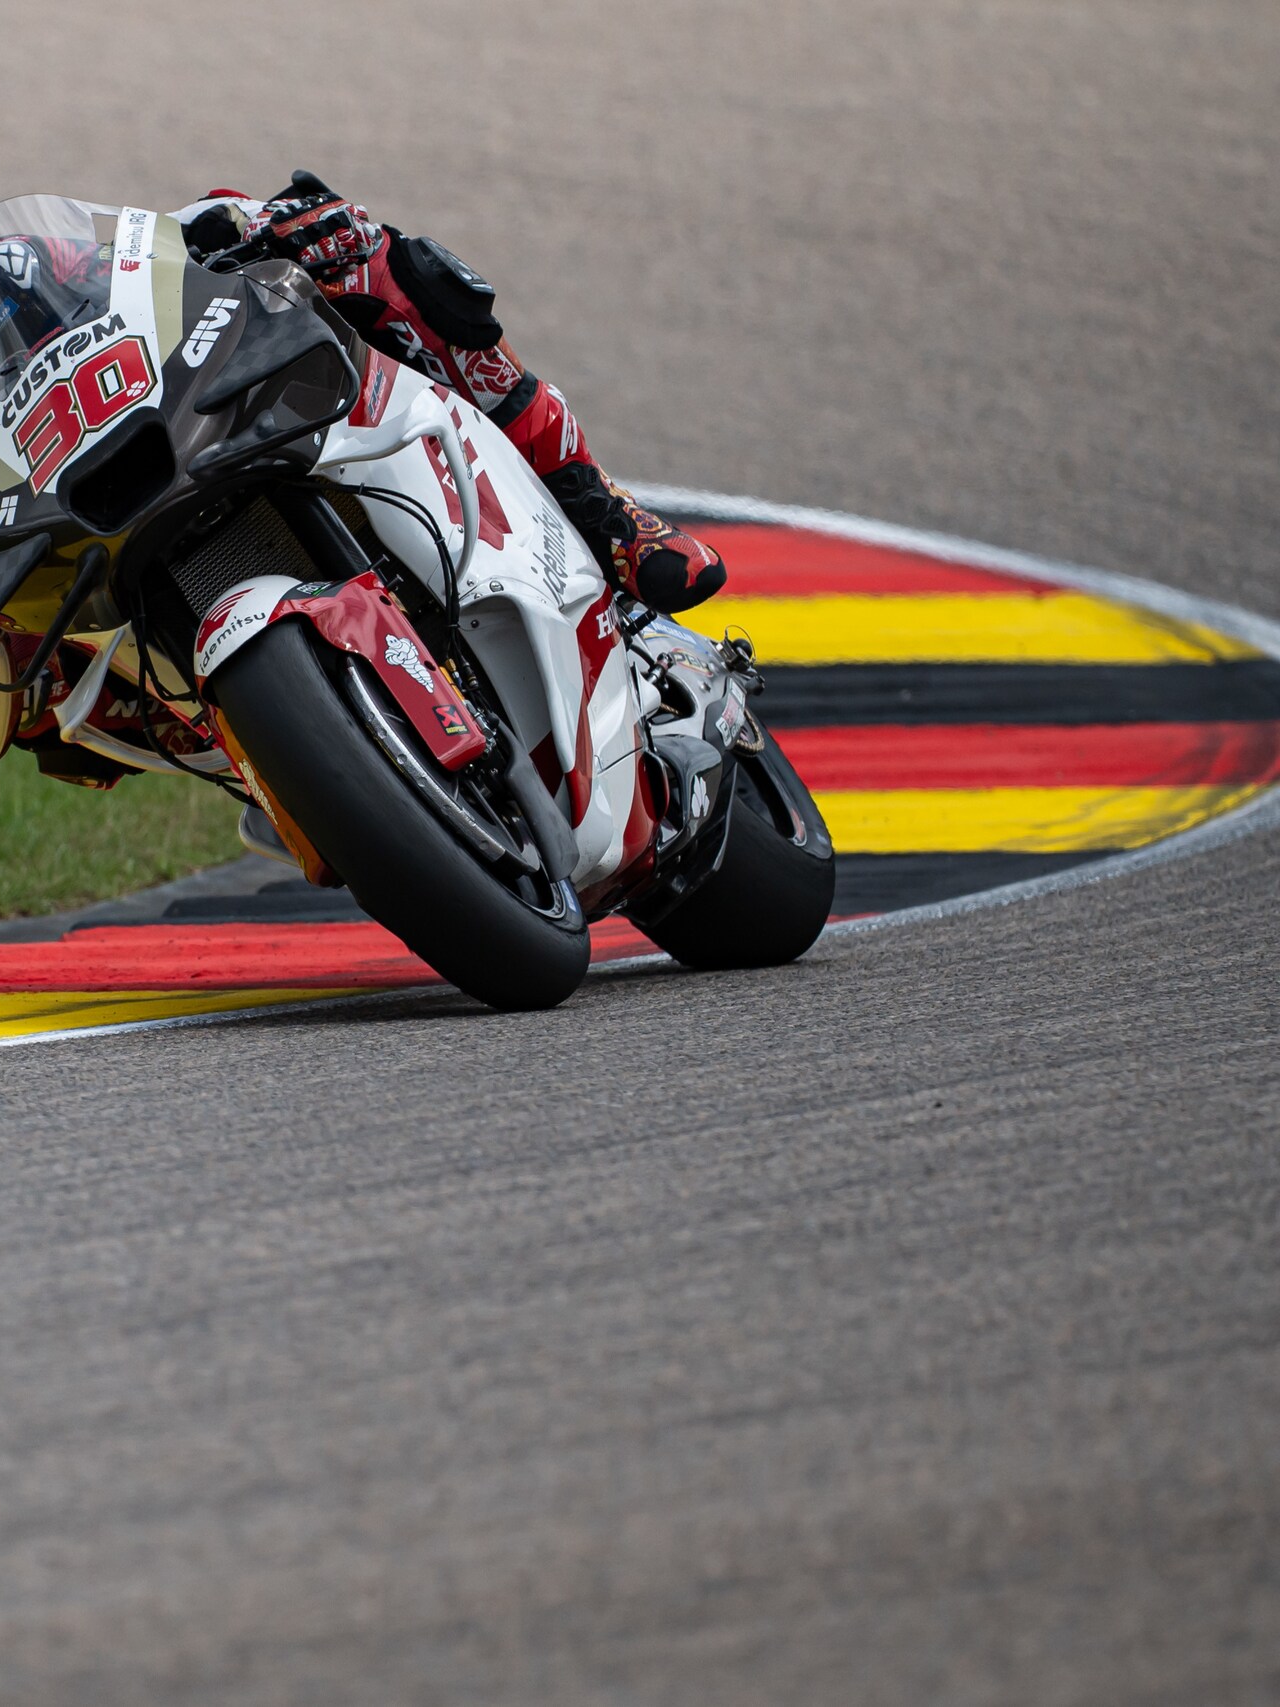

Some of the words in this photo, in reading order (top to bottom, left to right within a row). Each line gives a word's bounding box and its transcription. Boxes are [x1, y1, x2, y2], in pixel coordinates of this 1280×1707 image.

[128, 213, 147, 225] IRG
[1, 313, 127, 429] CUSTOM
[181, 297, 241, 368] GIVI
[12, 335, 158, 499] 30
[531, 502, 569, 606] idemitsu
[199, 612, 266, 673] idemitsu
